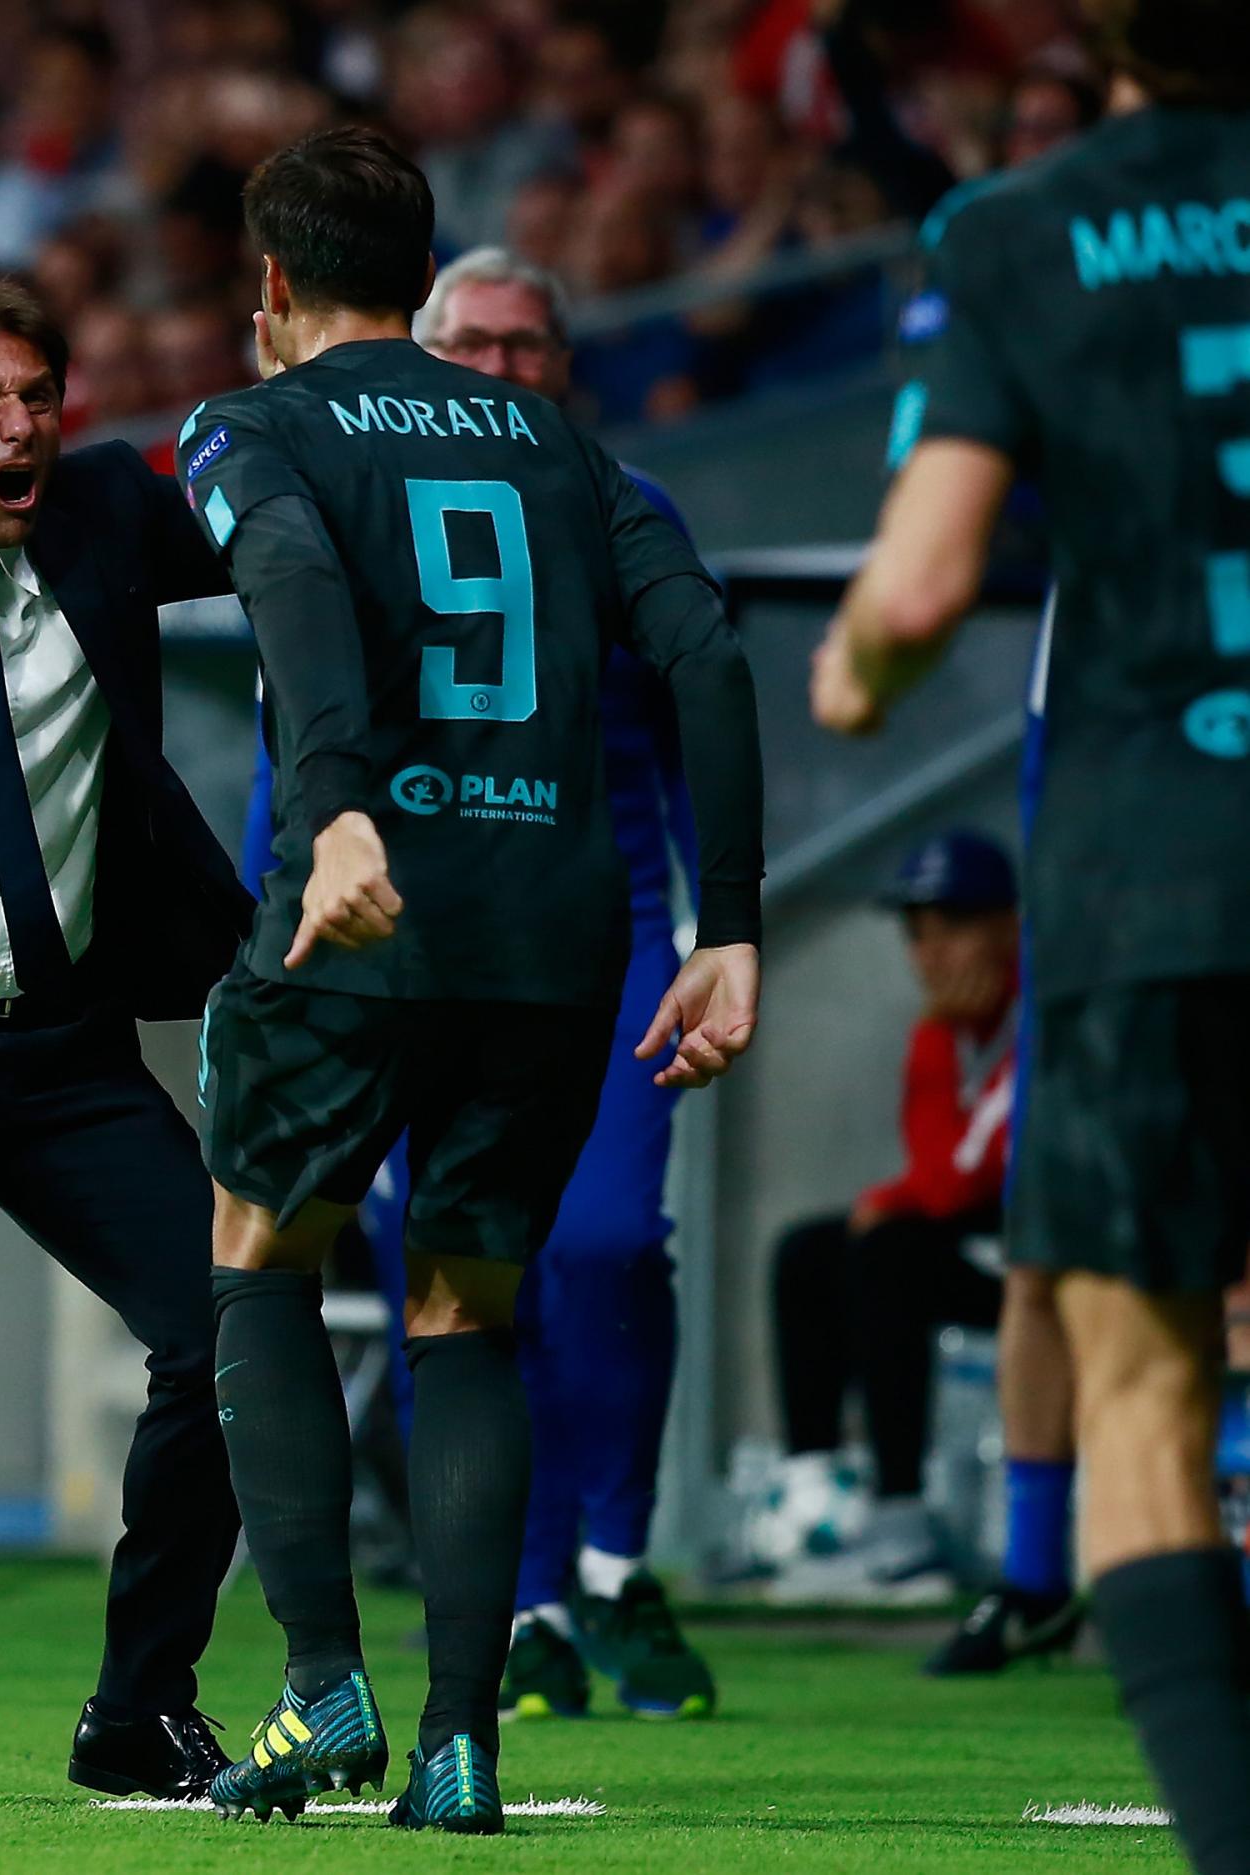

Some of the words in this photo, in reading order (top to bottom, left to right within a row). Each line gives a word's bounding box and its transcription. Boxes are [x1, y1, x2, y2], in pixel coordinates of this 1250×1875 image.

[328, 394, 539, 446] MORATA
[188, 430, 227, 477] SPECT
[405, 478, 537, 722] 9
[460, 774, 557, 810] PLAN
[459, 808, 557, 826] INTERNATIONAL
